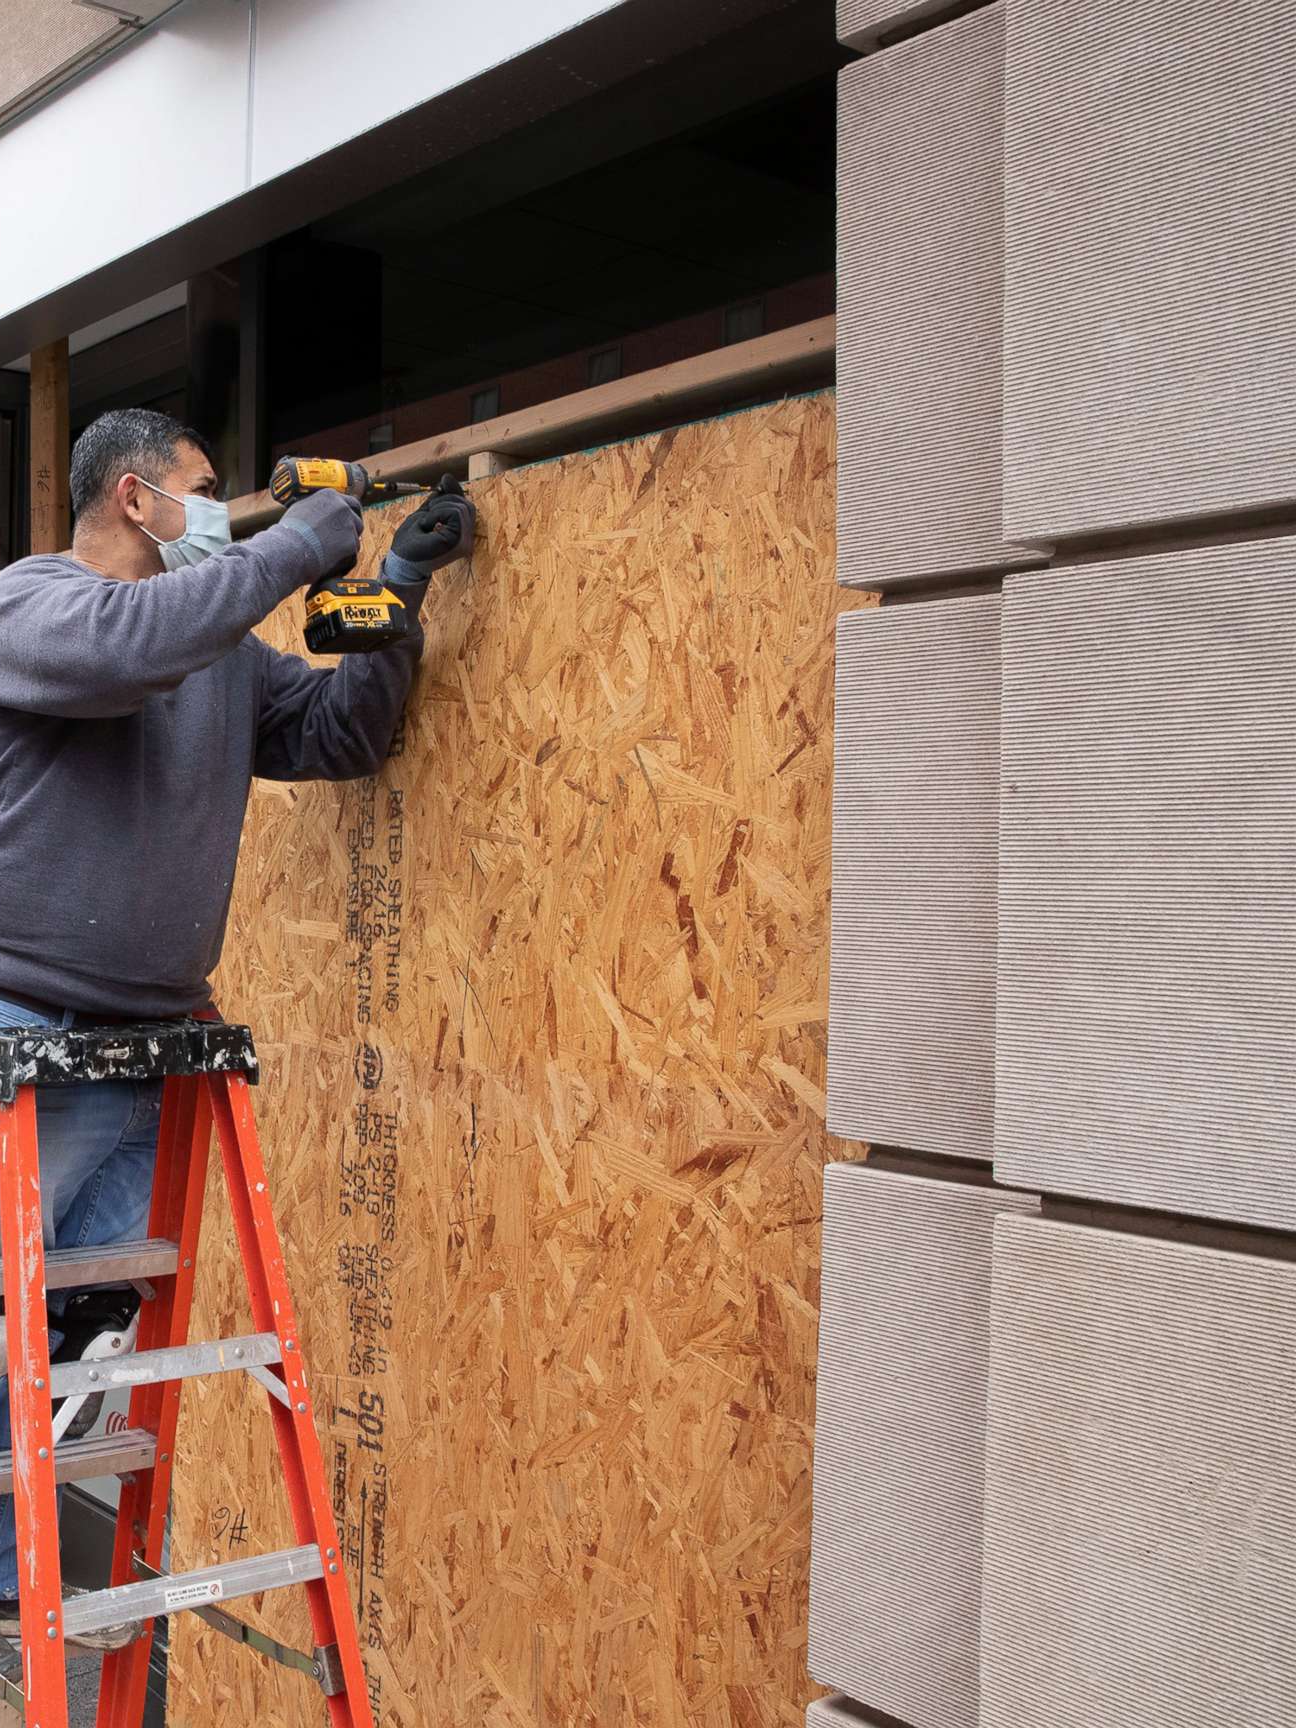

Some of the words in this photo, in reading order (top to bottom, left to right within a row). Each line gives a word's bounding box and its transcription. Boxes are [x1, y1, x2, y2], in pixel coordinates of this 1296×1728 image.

[389, 789, 403, 865] RATED
[346, 828, 360, 942] EXPOSURE
[373, 864, 388, 939] 24/16
[357, 922, 373, 1024] SPACING
[385, 878, 402, 1014] SHEATHING
[369, 1111, 383, 1143] PS
[339, 1159, 353, 1217] 7/16
[367, 1155, 382, 1217] 2-18
[381, 1111, 398, 1242] THICKNESS
[362, 1243, 379, 1375] SHEATHING
[357, 1390, 385, 1453] 501
[370, 1461, 388, 1580] STRENGTH
[367, 1589, 383, 1651] AXIS
